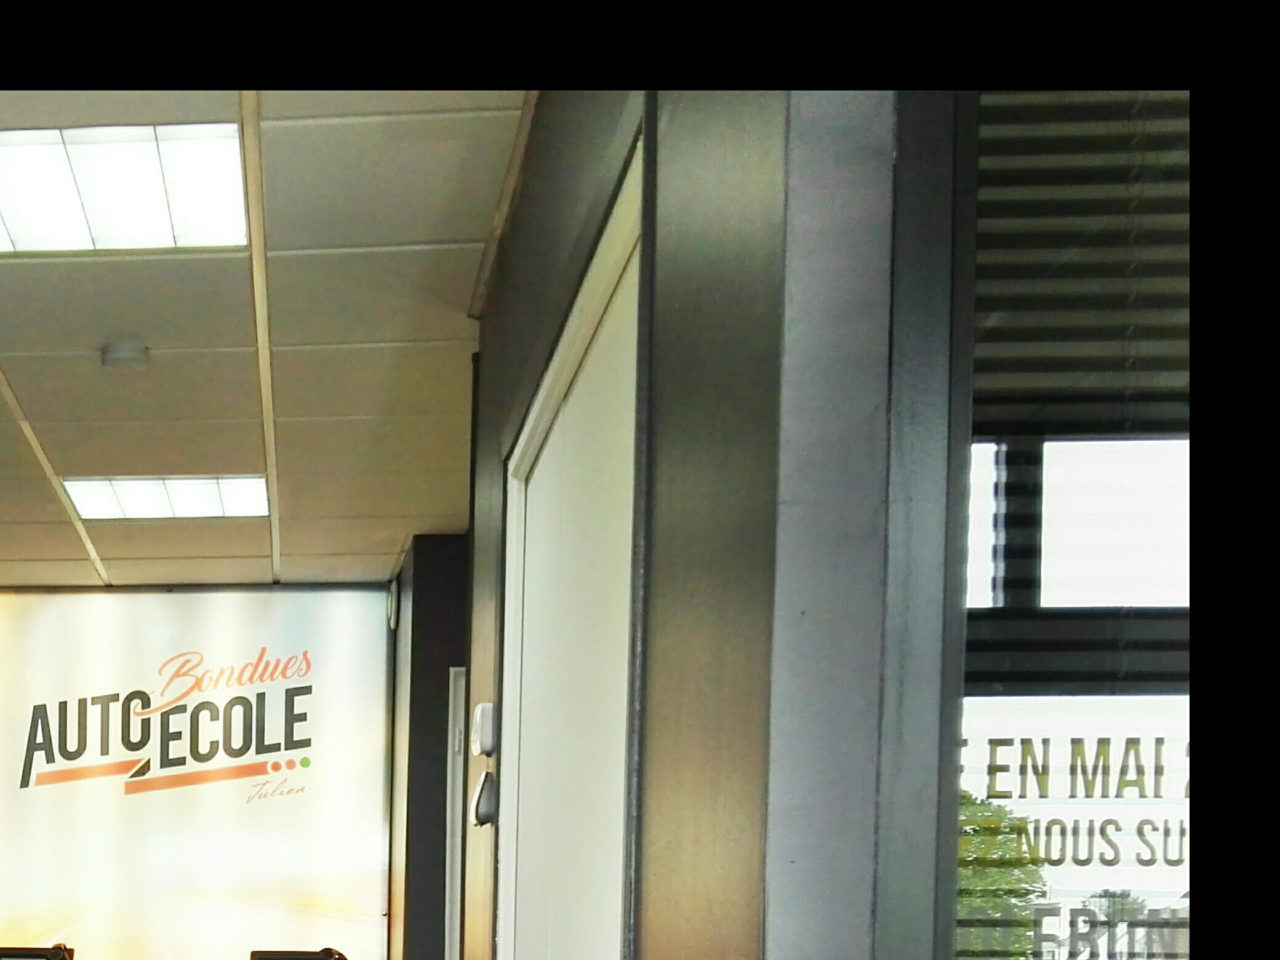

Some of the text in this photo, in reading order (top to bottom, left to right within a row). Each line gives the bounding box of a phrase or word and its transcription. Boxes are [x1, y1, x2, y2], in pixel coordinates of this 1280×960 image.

[133, 647, 312, 717] Bondues
[20, 684, 313, 788] AUTO ECOLE
[986, 737, 1051, 799] EN
[1016, 817, 1122, 867] NOUS
